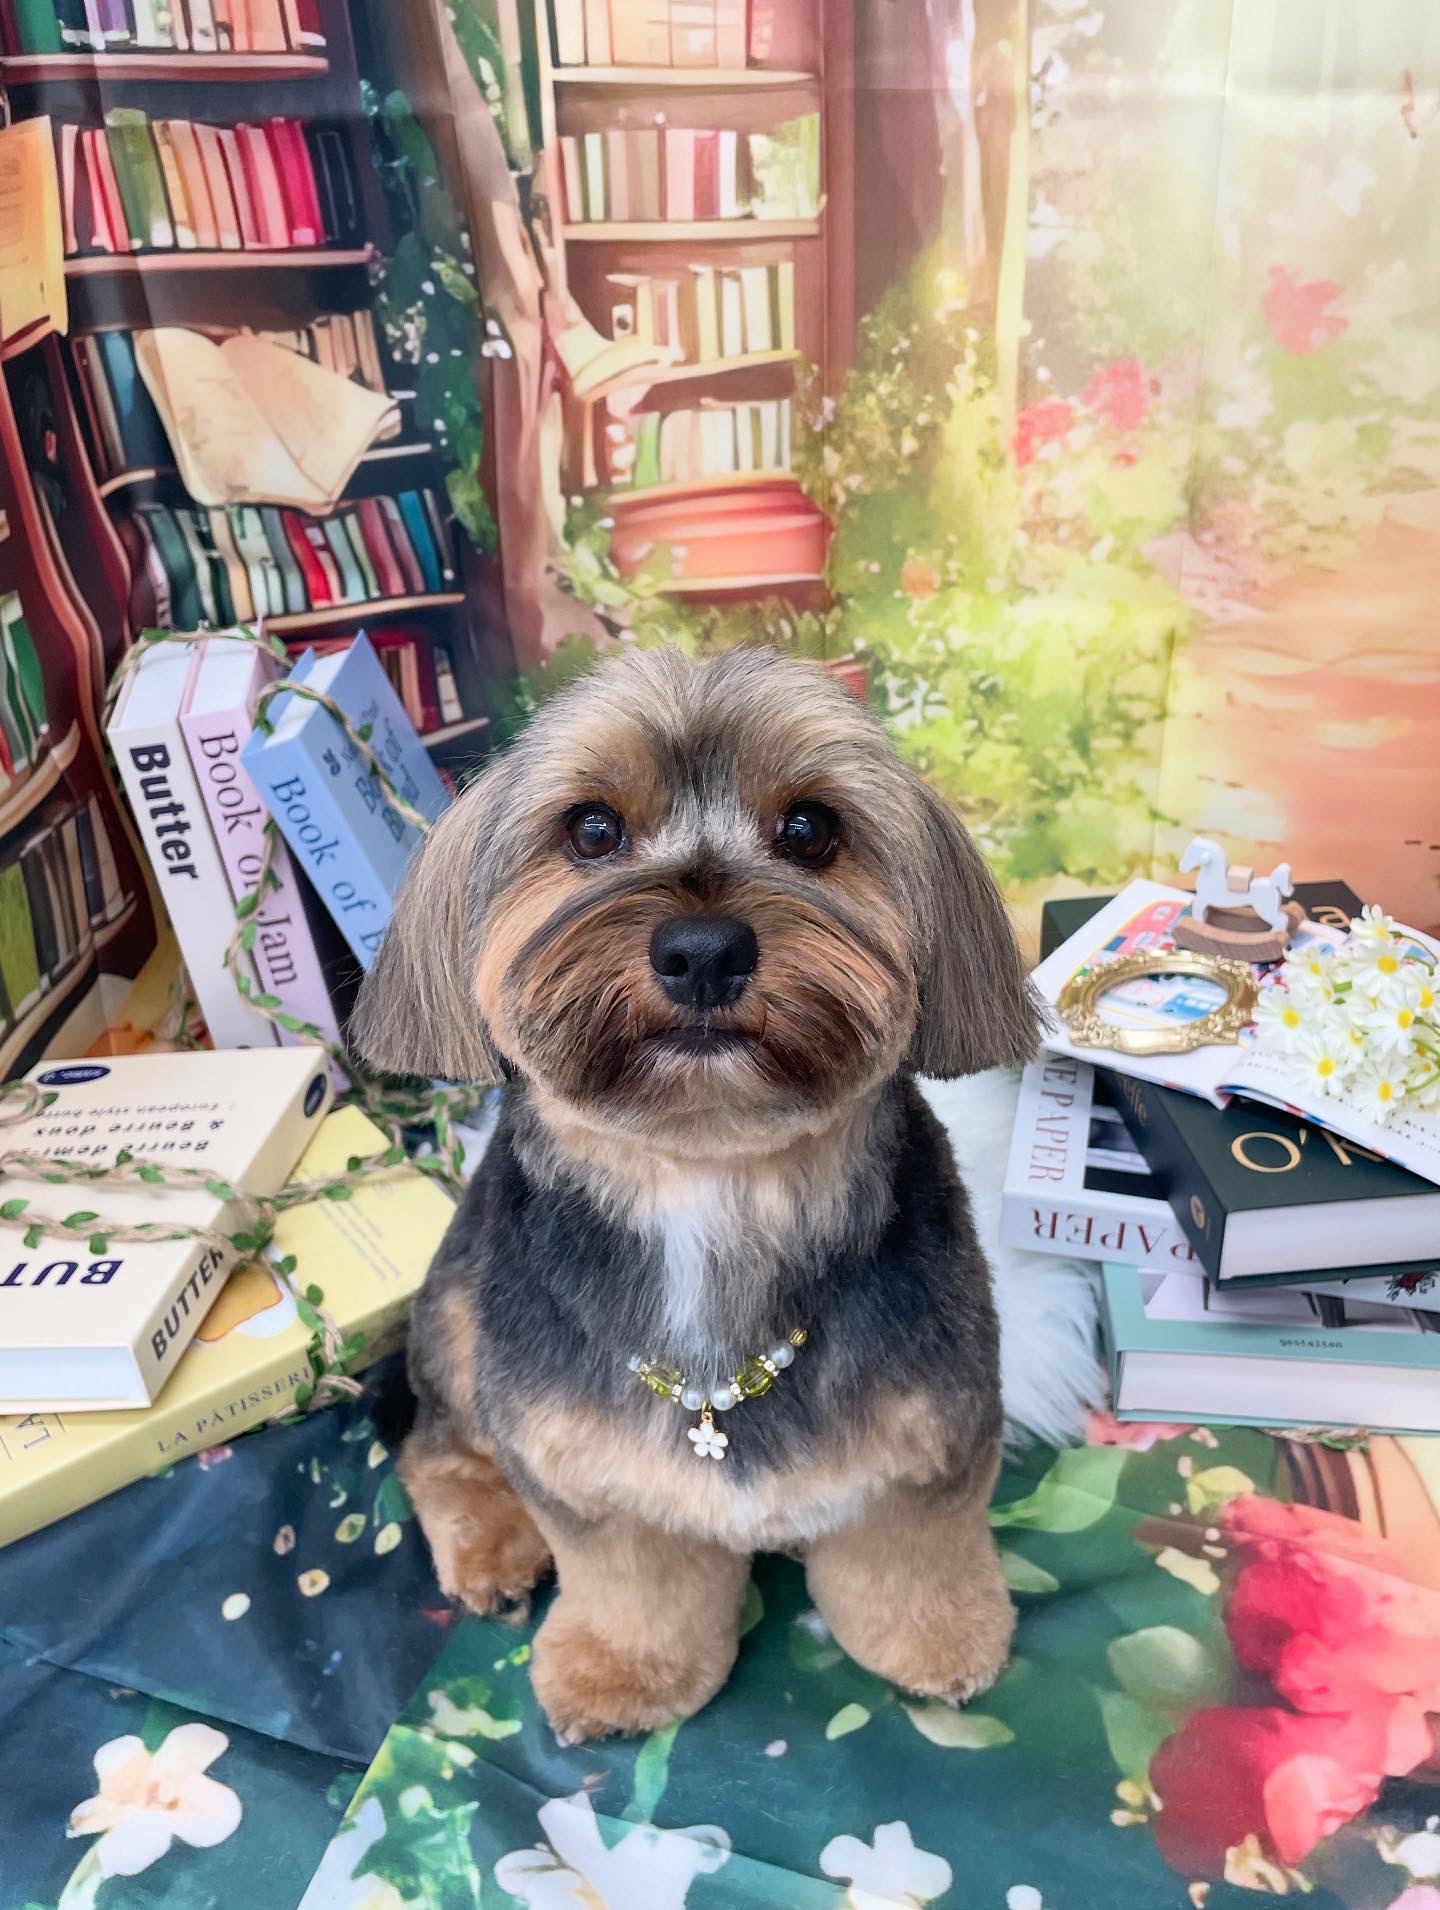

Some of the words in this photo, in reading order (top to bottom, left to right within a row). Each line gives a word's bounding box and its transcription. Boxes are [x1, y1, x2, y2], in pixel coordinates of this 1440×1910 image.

[130, 743, 199, 880] Butter
[199, 731, 262, 835] Book
[256, 913, 297, 986] Jam
[271, 775, 340, 867] Book
[332, 881, 377, 913] of
[34, 1124, 97, 1137] doux
[108, 1120, 195, 1134] Beurre
[1027, 1089, 1075, 1181] PAPER
[120, 1140, 209, 1153] Beurre
[1032, 1207, 1199, 1261] PAPER
[0, 1259, 124, 1286] BUT
[17, 1412, 51, 1450] LA
[158, 1431, 189, 1452] LA
